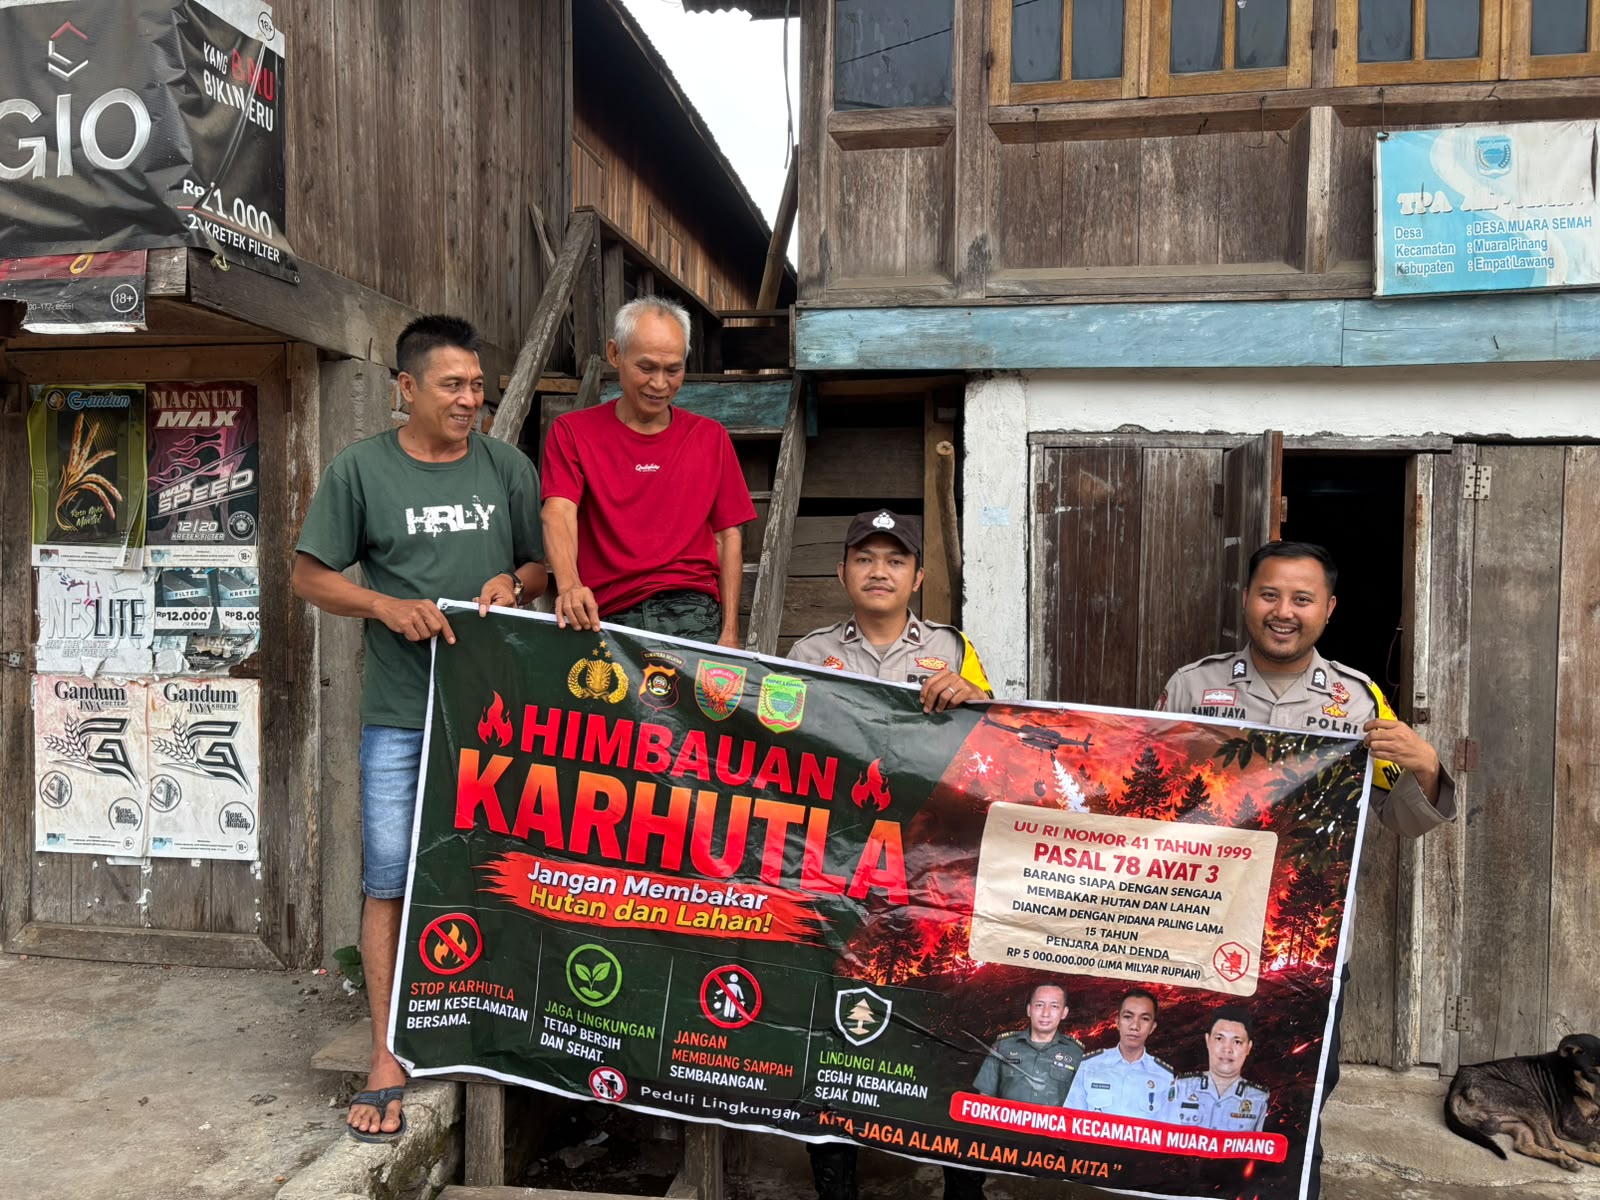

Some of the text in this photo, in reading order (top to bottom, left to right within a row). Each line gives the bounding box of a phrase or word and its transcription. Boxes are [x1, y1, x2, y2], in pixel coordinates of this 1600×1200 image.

[203, 41, 228, 75] YANG
[203, 69, 245, 114] BIKIN
[182, 179, 205, 198] Rp
[1397, 190, 1453, 216] TPA
[1395, 226, 1422, 240] Desa
[1507, 218, 1549, 233] MUARA
[1551, 215, 1592, 230] SEMAH
[205, 220, 246, 250] KRETEK
[248, 238, 280, 263] FILTER
[1395, 242, 1455, 257] Kecamatan
[1510, 238, 1549, 252] Pinang
[1395, 261, 1454, 276] Kabupaten
[1512, 255, 1555, 270] Lawang
[114, 292, 134, 304] 18+
[67, 390, 130, 410] Gandum
[152, 389, 243, 409] MAGNUM
[156, 409, 241, 429] MAX
[158, 469, 254, 514] SPEED
[159, 478, 197, 500] MAX
[405, 500, 495, 536] HRLY
[229, 589, 257, 597] KRETEK
[54, 681, 127, 700] Gandum
[163, 683, 238, 704] Gandum
[77, 701, 102, 712] JAYA
[187, 703, 239, 714] JAYA KRETEK
[1191, 706, 1246, 719] SANDI JAYA
[1305, 716, 1359, 735] POLRI
[520, 704, 838, 801] HIMBAUAN
[453, 748, 909, 906] KARHUTLA
[1014, 820, 1252, 860] UU RI NOMOR 41 TAHUN 1999
[1033, 842, 1220, 884] PASAL 78 AYAT 3
[527, 861, 769, 911] Jangan Membakar
[1023, 867, 1223, 901] BARANG SIAPA DENGAN SENGAJA
[530, 886, 774, 934] Hutan dan Lahan!
[1026, 884, 1210, 916] MEMBAKAR HUTAN DAN LAHAN
[1012, 900, 1224, 935] DIANCAM DENGAN PIDANA PALING LAMA
[1046, 935, 1170, 960] PENJARA DAN DENDA
[1085, 927, 1139, 941] 15 TAHUN
[1006, 947, 1021, 957] RP
[1097, 959, 1123, 970] (LIMA
[1125, 962, 1160, 974] MILYAR
[1161, 966, 1201, 980] RUPIAH)
[410, 980, 515, 1001] STOP KARHUTLA
[406, 1013, 471, 1029] BERSAMA.
[408, 997, 529, 1022] DEMI KESELAMATAN
[544, 1000, 656, 1040] JAGA LINGKUNGAN
[543, 1016, 621, 1051] TETAP BERSIH
[674, 1030, 728, 1050] JANGAN
[540, 1032, 605, 1064] DAN SEHAT.
[671, 1048, 794, 1078] MEMBUANG SAMPAH
[819, 1050, 918, 1082] LINDUNGI ALAM,
[669, 1065, 768, 1092] SEMBARANGAN.
[816, 1069, 929, 1100] CEGAH KEBAKARAN
[640, 1086, 801, 1122] Peduli Lingkungan
[814, 1085, 880, 1108] SEJAK DINI.
[962, 1100, 1276, 1155] FORKOMPIMCA KECAMATAN MUARA PINANG
[858, 1121, 904, 1146] JAGA
[908, 1130, 963, 1159] ALAM,
[966, 1141, 1020, 1165] ALAM
[1021, 1150, 1066, 1174] JAGA
